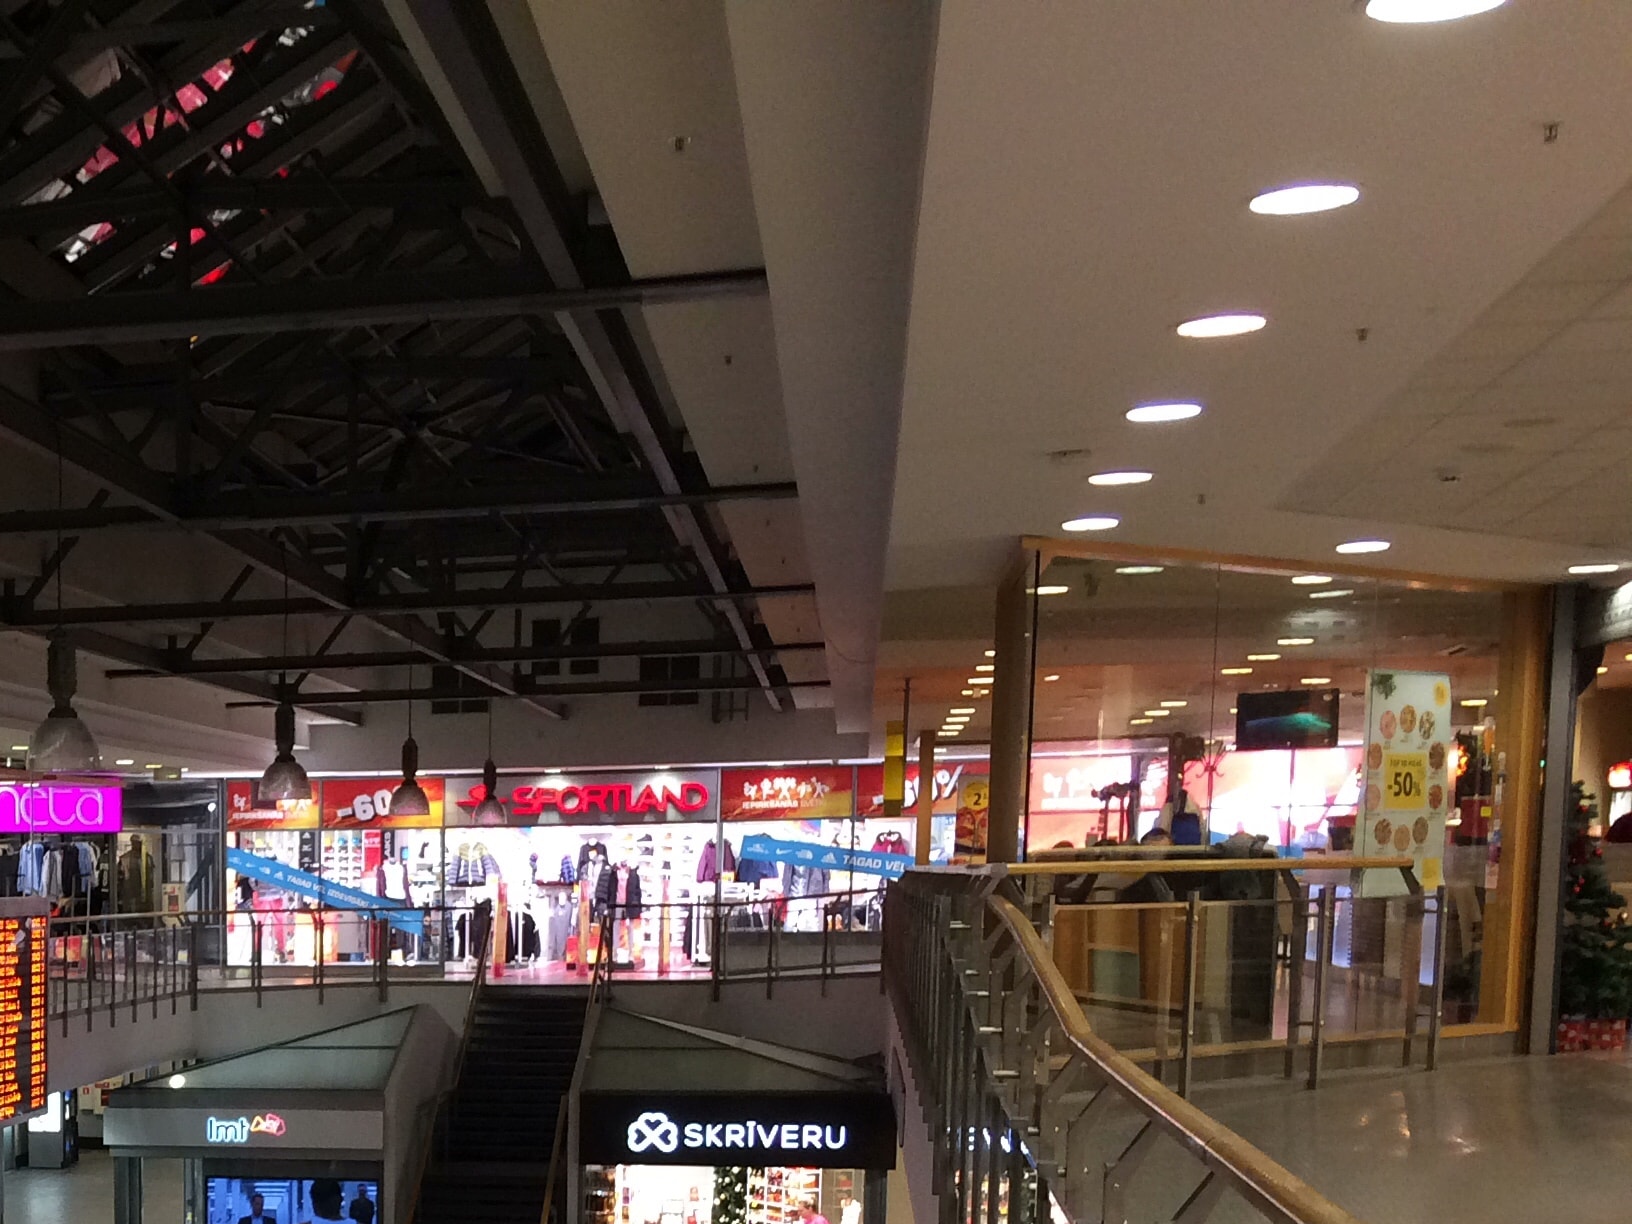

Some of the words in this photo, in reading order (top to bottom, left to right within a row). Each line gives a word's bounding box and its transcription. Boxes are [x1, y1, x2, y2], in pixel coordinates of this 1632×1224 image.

[336, 786, 399, 822] -60
[512, 782, 709, 815] SPORTLAND
[843, 854, 882, 869] TAGAD
[207, 1117, 250, 1142] lmt
[684, 1120, 846, 1150] SKRĪVERU
